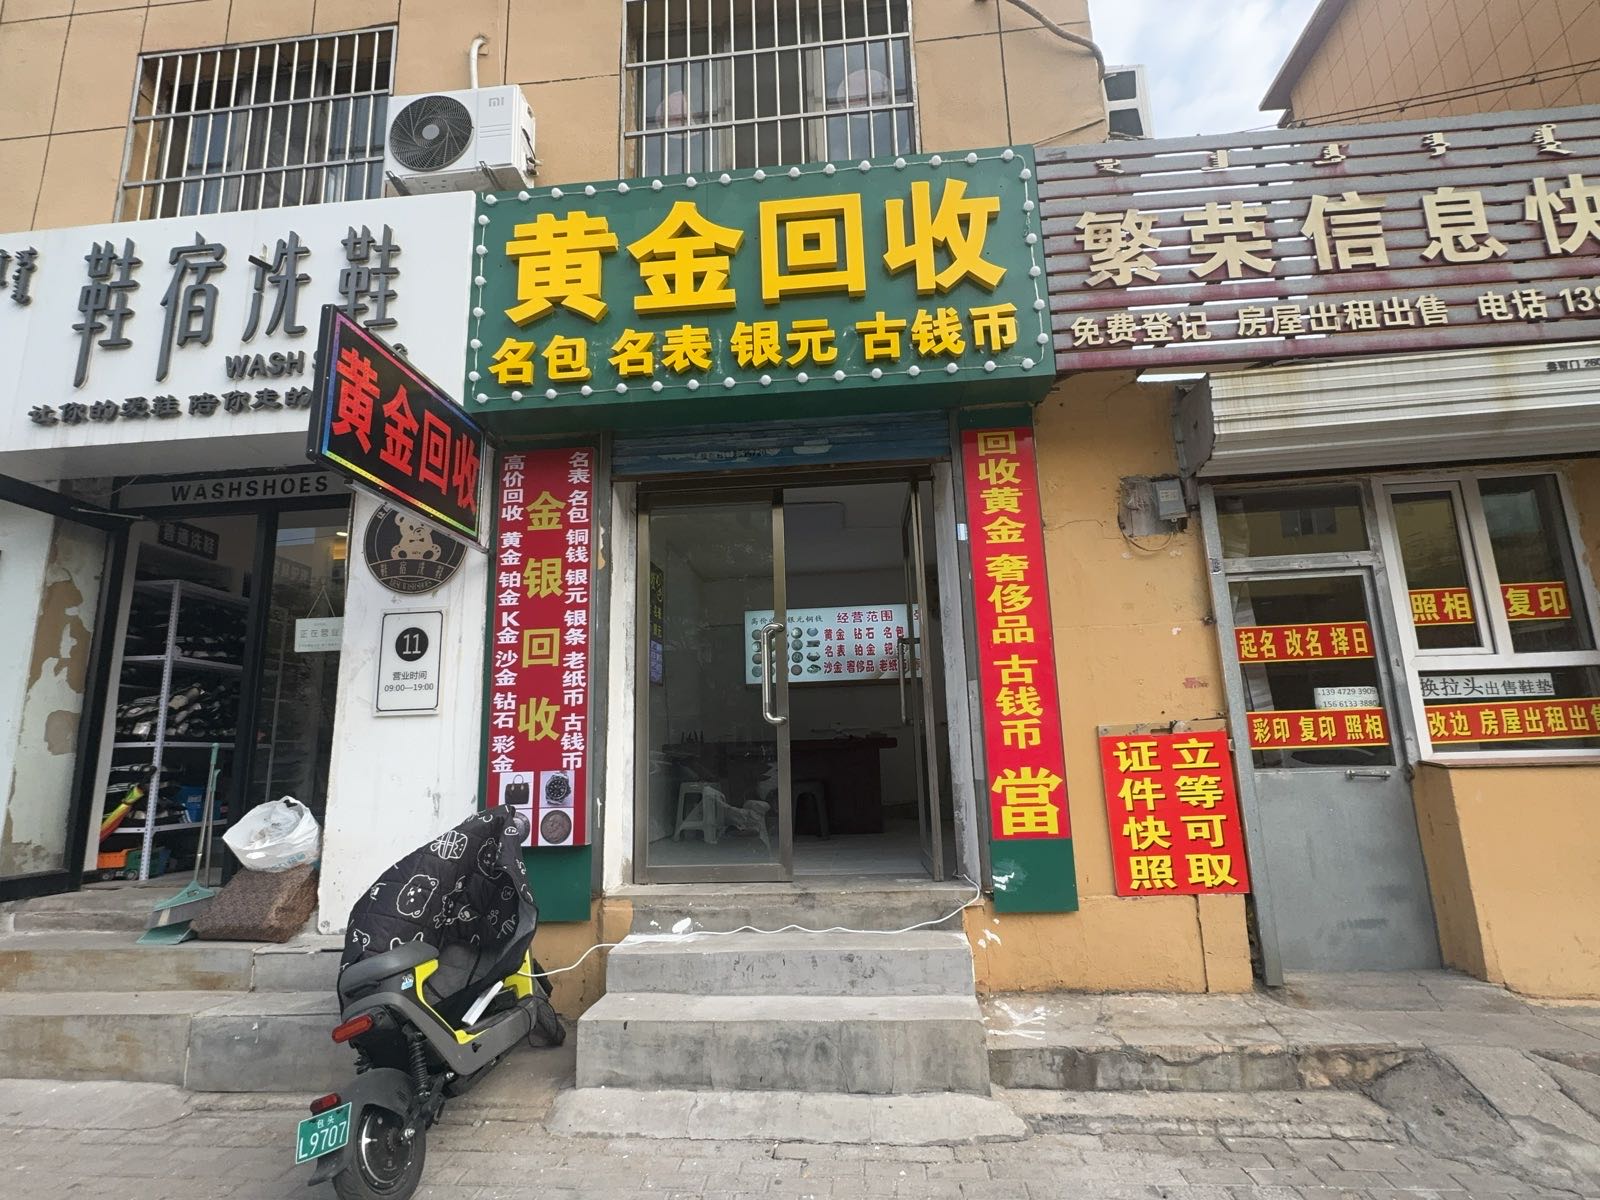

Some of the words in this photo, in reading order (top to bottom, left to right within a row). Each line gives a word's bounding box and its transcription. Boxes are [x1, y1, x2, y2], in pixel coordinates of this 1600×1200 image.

[1077, 173, 1600, 287] 繁荣信息快
[504, 177, 1006, 327] 黄金回收
[73, 223, 401, 388] 鞋宿洗鞋
[1070, 311, 1212, 347] 免费登记
[1238, 295, 1449, 338] 房屋出租出售
[1478, 289, 1548, 320] 电话
[489, 334, 592, 386] 名包
[609, 325, 713, 378] 名表
[731, 319, 838, 369] 银元
[856, 302, 1018, 362] 古钱币
[225, 350, 305, 379] WASH
[28, 395, 182, 426] 让你的爱鞋
[331, 346, 480, 515] 黄金回收
[568, 451, 590, 484] 名表
[171, 476, 328, 501] WASHSHOES
[501, 454, 526, 521] 高价回收
[977, 431, 1026, 544] 回收黄金
[567, 490, 590, 523] 名包
[500, 532, 523, 566] 黄金
[565, 528, 589, 563] 铜钱
[498, 571, 521, 606] 铂金
[564, 569, 588, 604] 银元
[986, 553, 1034, 644] 奢侈品
[518, 490, 567, 741] 金银回收
[837, 610, 893, 623] 经营范围
[1411, 592, 1472, 622] 照相
[1505, 587, 1567, 616] 复印
[402, 633, 421, 655] 11
[497, 611, 520, 645] K金
[563, 609, 587, 646] 银条
[824, 628, 845, 641] 黄金
[854, 627, 874, 639] 钻石
[883, 626, 904, 639] 名包
[1239, 630, 1277, 659] 起名
[1284, 628, 1323, 657] 改名
[1330, 626, 1369, 655] 择日
[824, 661, 843, 674] 沙金
[846, 660, 875, 673] 奢侈品
[825, 644, 846, 657] 名表
[854, 643, 875, 656] 铂金
[393, 671, 427, 681] 营业时间
[494, 651, 518, 686] 沙金
[562, 651, 587, 707] 老纸币
[493, 692, 517, 729] 钻石
[993, 654, 1044, 750] 古钱币
[1253, 716, 1290, 744] 彩印
[1298, 715, 1337, 742] 复印
[1344, 713, 1384, 740] 照相
[1427, 710, 1472, 737] 改边
[491, 735, 515, 773] 彩金
[560, 713, 585, 770] 古钱币
[1113, 741, 1178, 890] 证件快照
[1172, 738, 1238, 888] 立等可取
[298, 1121, 347, 1159] L9707
